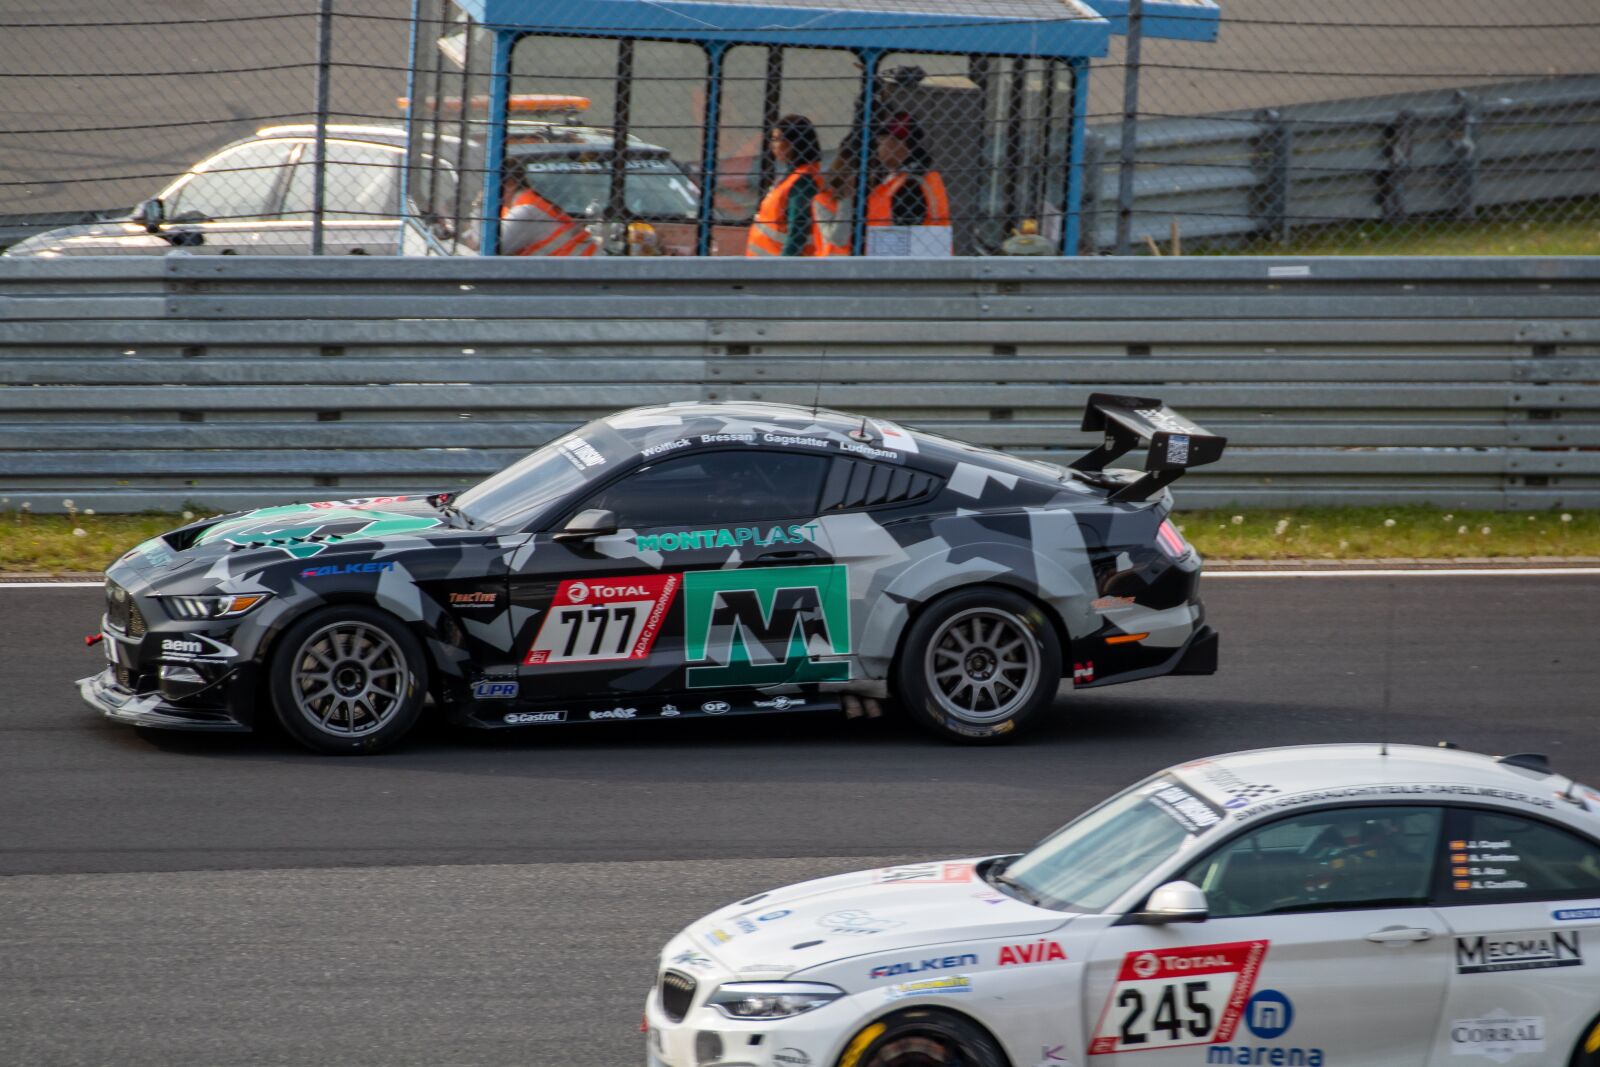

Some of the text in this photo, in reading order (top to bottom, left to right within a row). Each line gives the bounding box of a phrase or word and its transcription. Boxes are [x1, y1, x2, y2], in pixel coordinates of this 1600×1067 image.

[701, 433, 753, 443] Bressan
[763, 433, 830, 448] Gagstatter
[840, 441, 898, 459] Ludmann
[634, 524, 819, 552] MONTAPLAST
[301, 561, 395, 577] FALKEN
[591, 584, 651, 598] TOTAL
[560, 607, 637, 657] 777
[634, 630, 653, 657] ADAC
[518, 711, 561, 723] Castrol
[998, 939, 1068, 966] AVIA
[1162, 954, 1233, 971] TOTAL
[869, 953, 979, 979] FALKEN
[1116, 980, 1213, 1045] 245
[1206, 1046, 1325, 1067] marena
